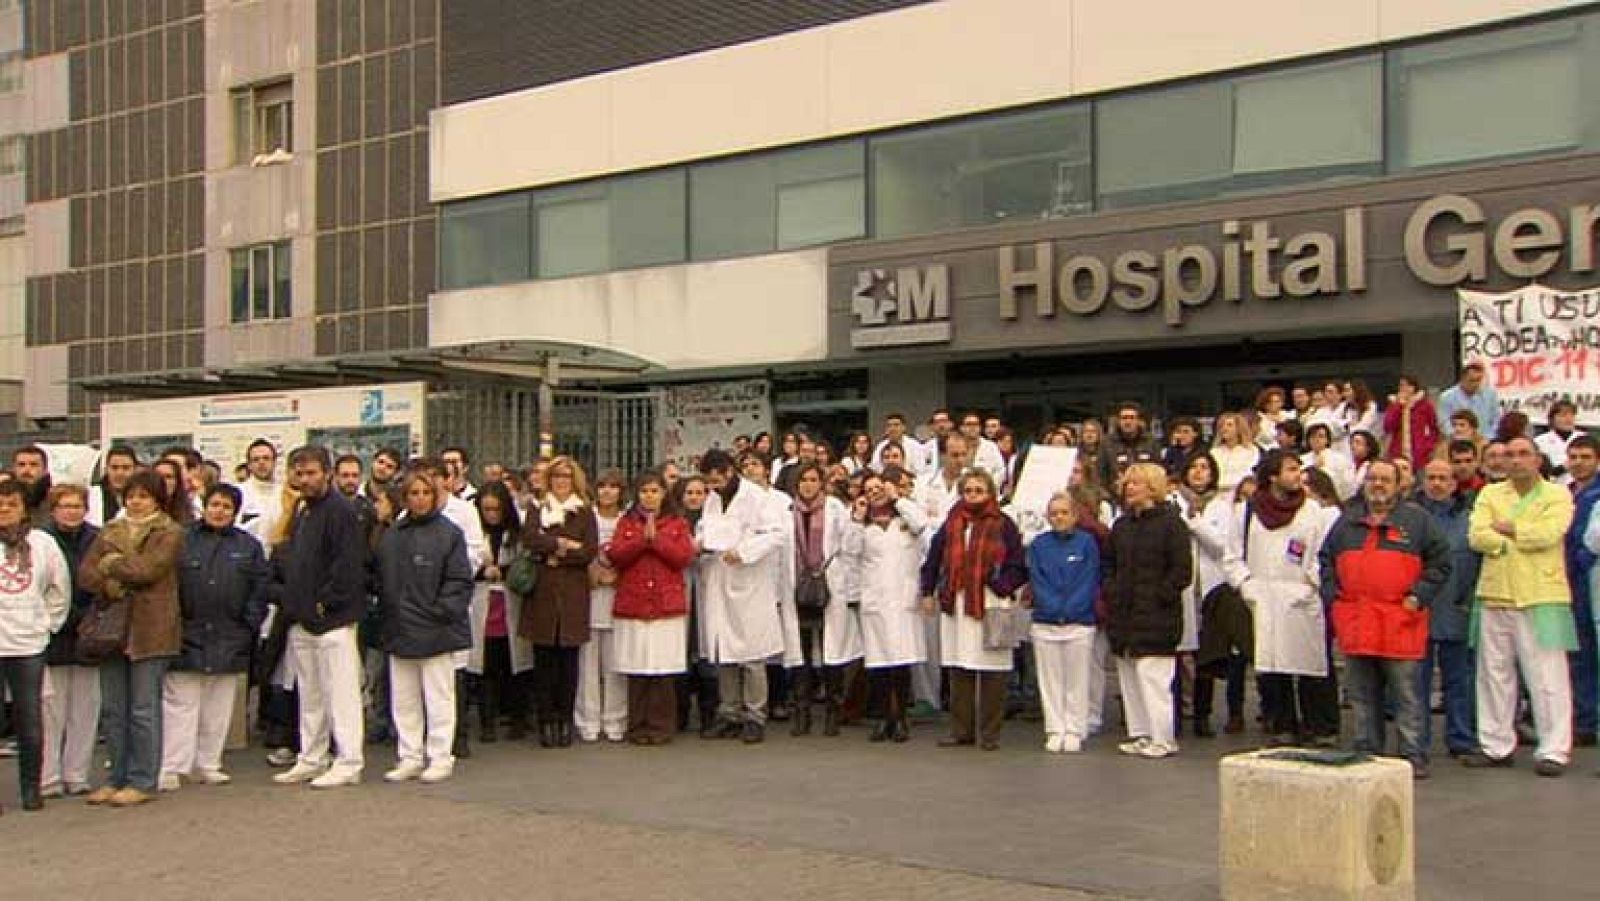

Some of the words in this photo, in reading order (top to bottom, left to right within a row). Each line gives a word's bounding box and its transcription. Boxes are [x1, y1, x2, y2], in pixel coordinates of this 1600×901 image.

[999, 207, 1367, 327] Hospital
[1464, 306, 1483, 326] A
[1493, 297, 1524, 325] TI
[1463, 325, 1551, 358] RODEA
